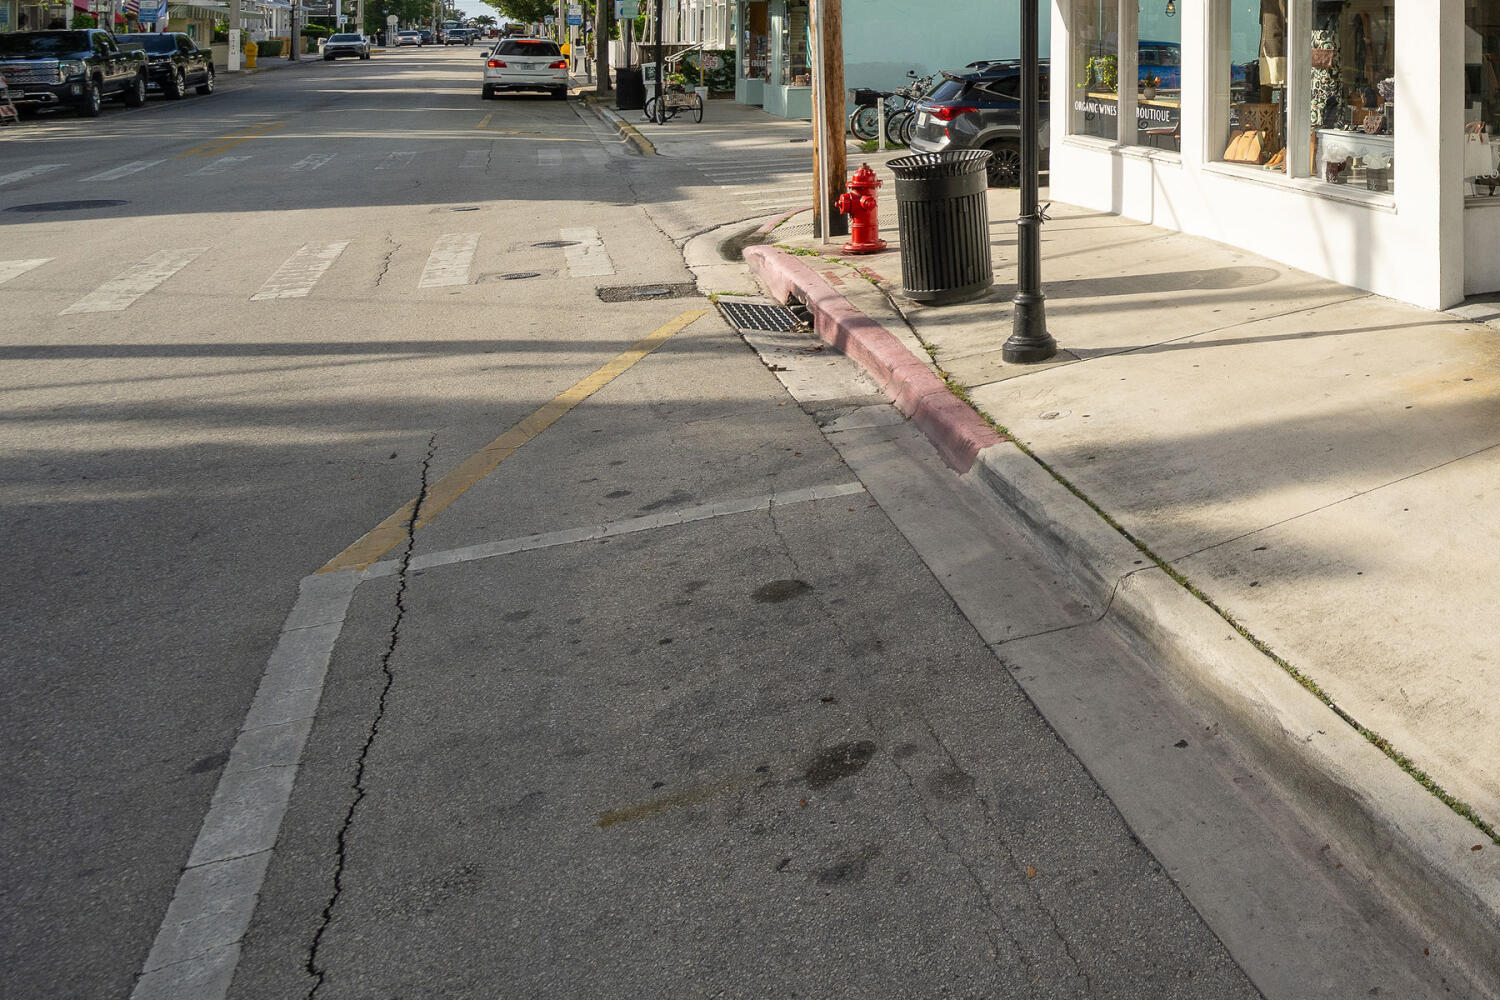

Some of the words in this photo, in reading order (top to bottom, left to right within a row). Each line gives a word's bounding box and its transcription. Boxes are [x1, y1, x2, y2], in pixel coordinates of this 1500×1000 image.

[1074, 100, 1099, 114] ORGANIC
[1099, 103, 1117, 116] WINES
[1136, 107, 1170, 123] BOUTIQUE
